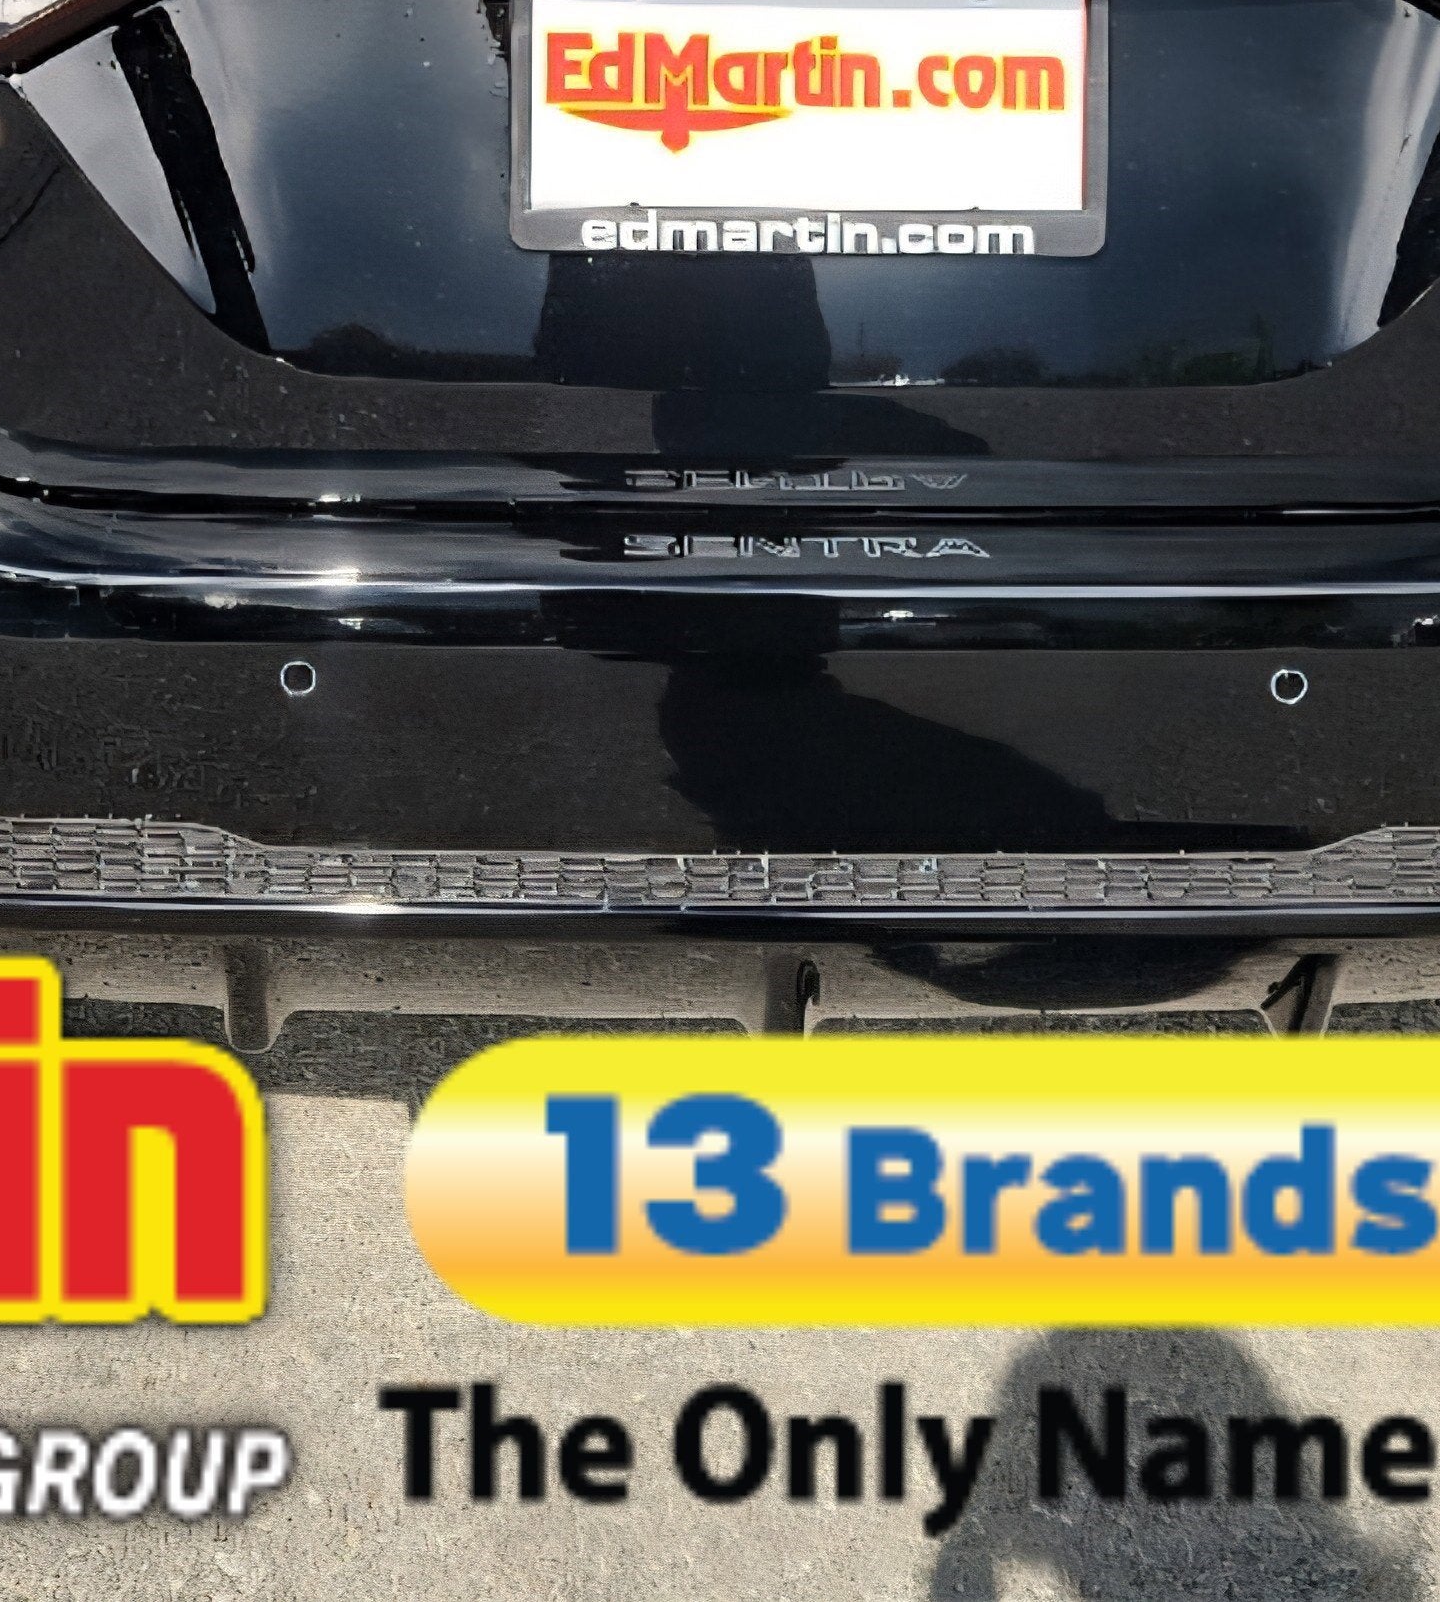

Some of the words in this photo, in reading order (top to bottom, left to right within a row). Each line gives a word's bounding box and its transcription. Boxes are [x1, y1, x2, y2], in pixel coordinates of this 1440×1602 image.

[545, 31, 1066, 112] EdMartin.com
[580, 211, 1034, 255] edmartin.com
[622, 533, 991, 559] SENTRA
